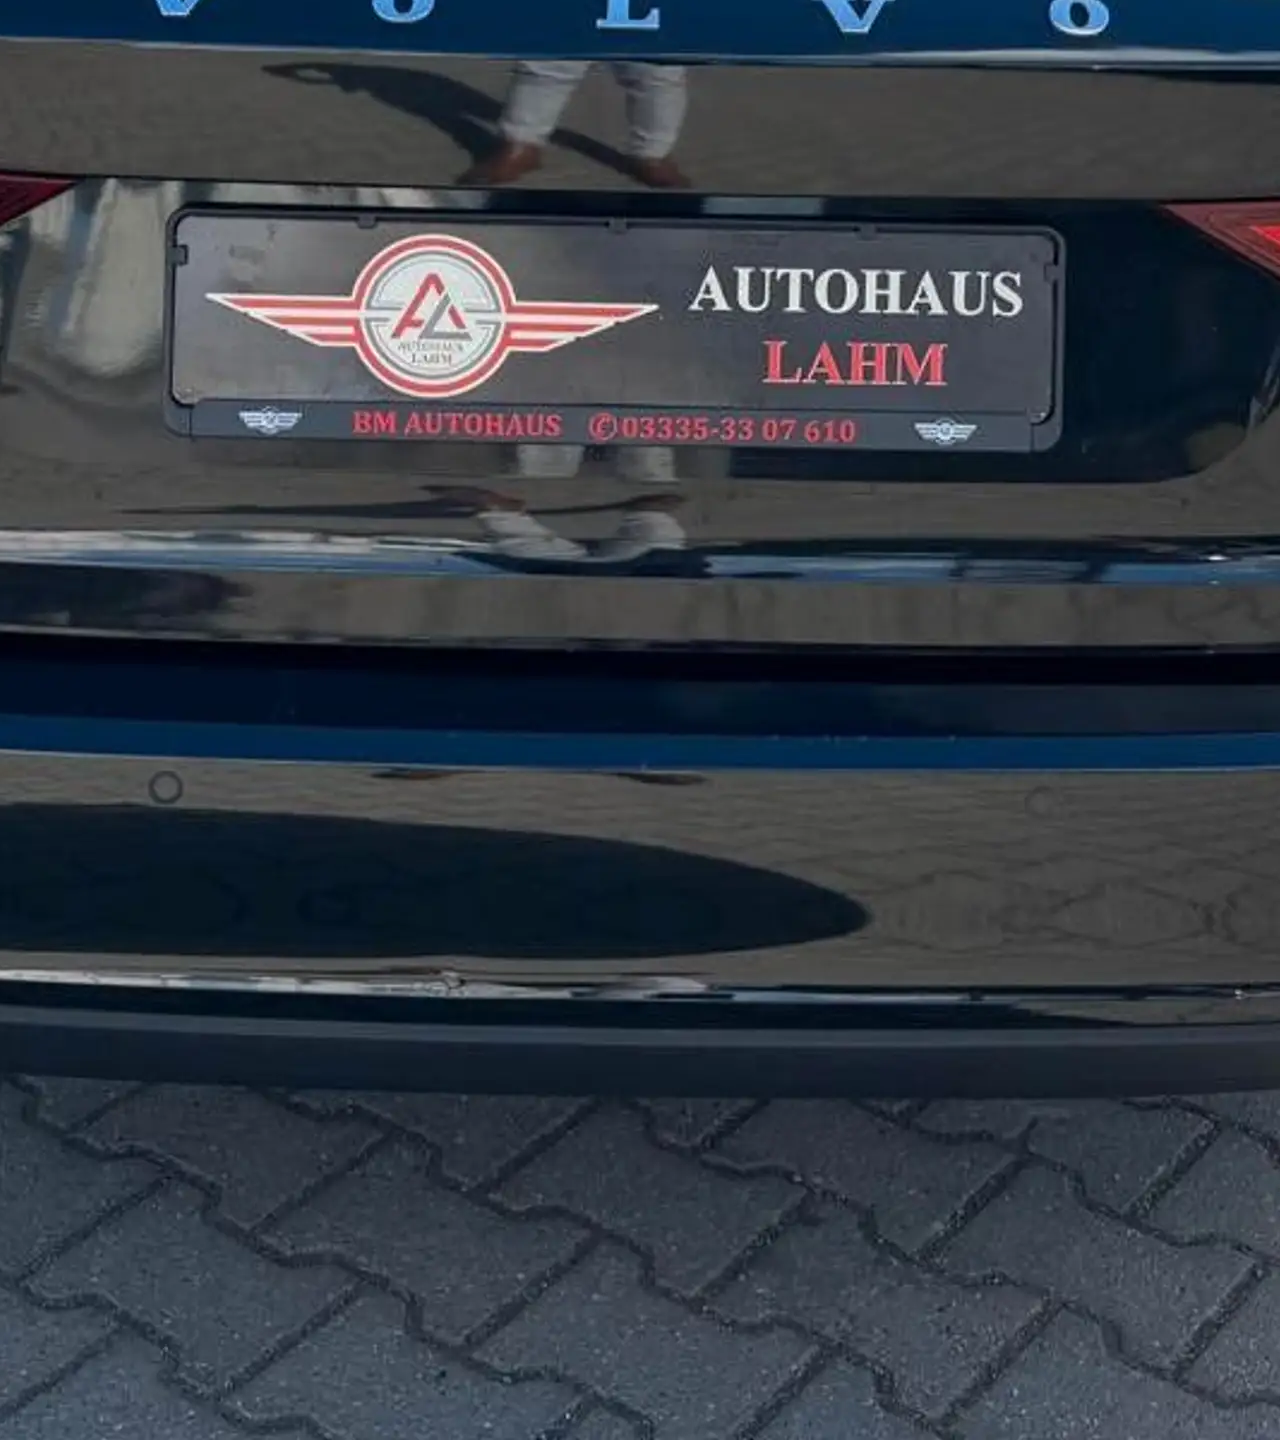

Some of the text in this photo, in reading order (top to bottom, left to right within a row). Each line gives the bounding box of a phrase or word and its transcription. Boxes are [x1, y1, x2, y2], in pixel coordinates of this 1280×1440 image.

[688, 265, 1024, 320] AUTOHAUS
[761, 339, 950, 389] LAHM
[351, 409, 398, 435] BM
[403, 410, 564, 438] AUTOHAUS
[761, 418, 797, 443] 07
[803, 418, 857, 444] 610
